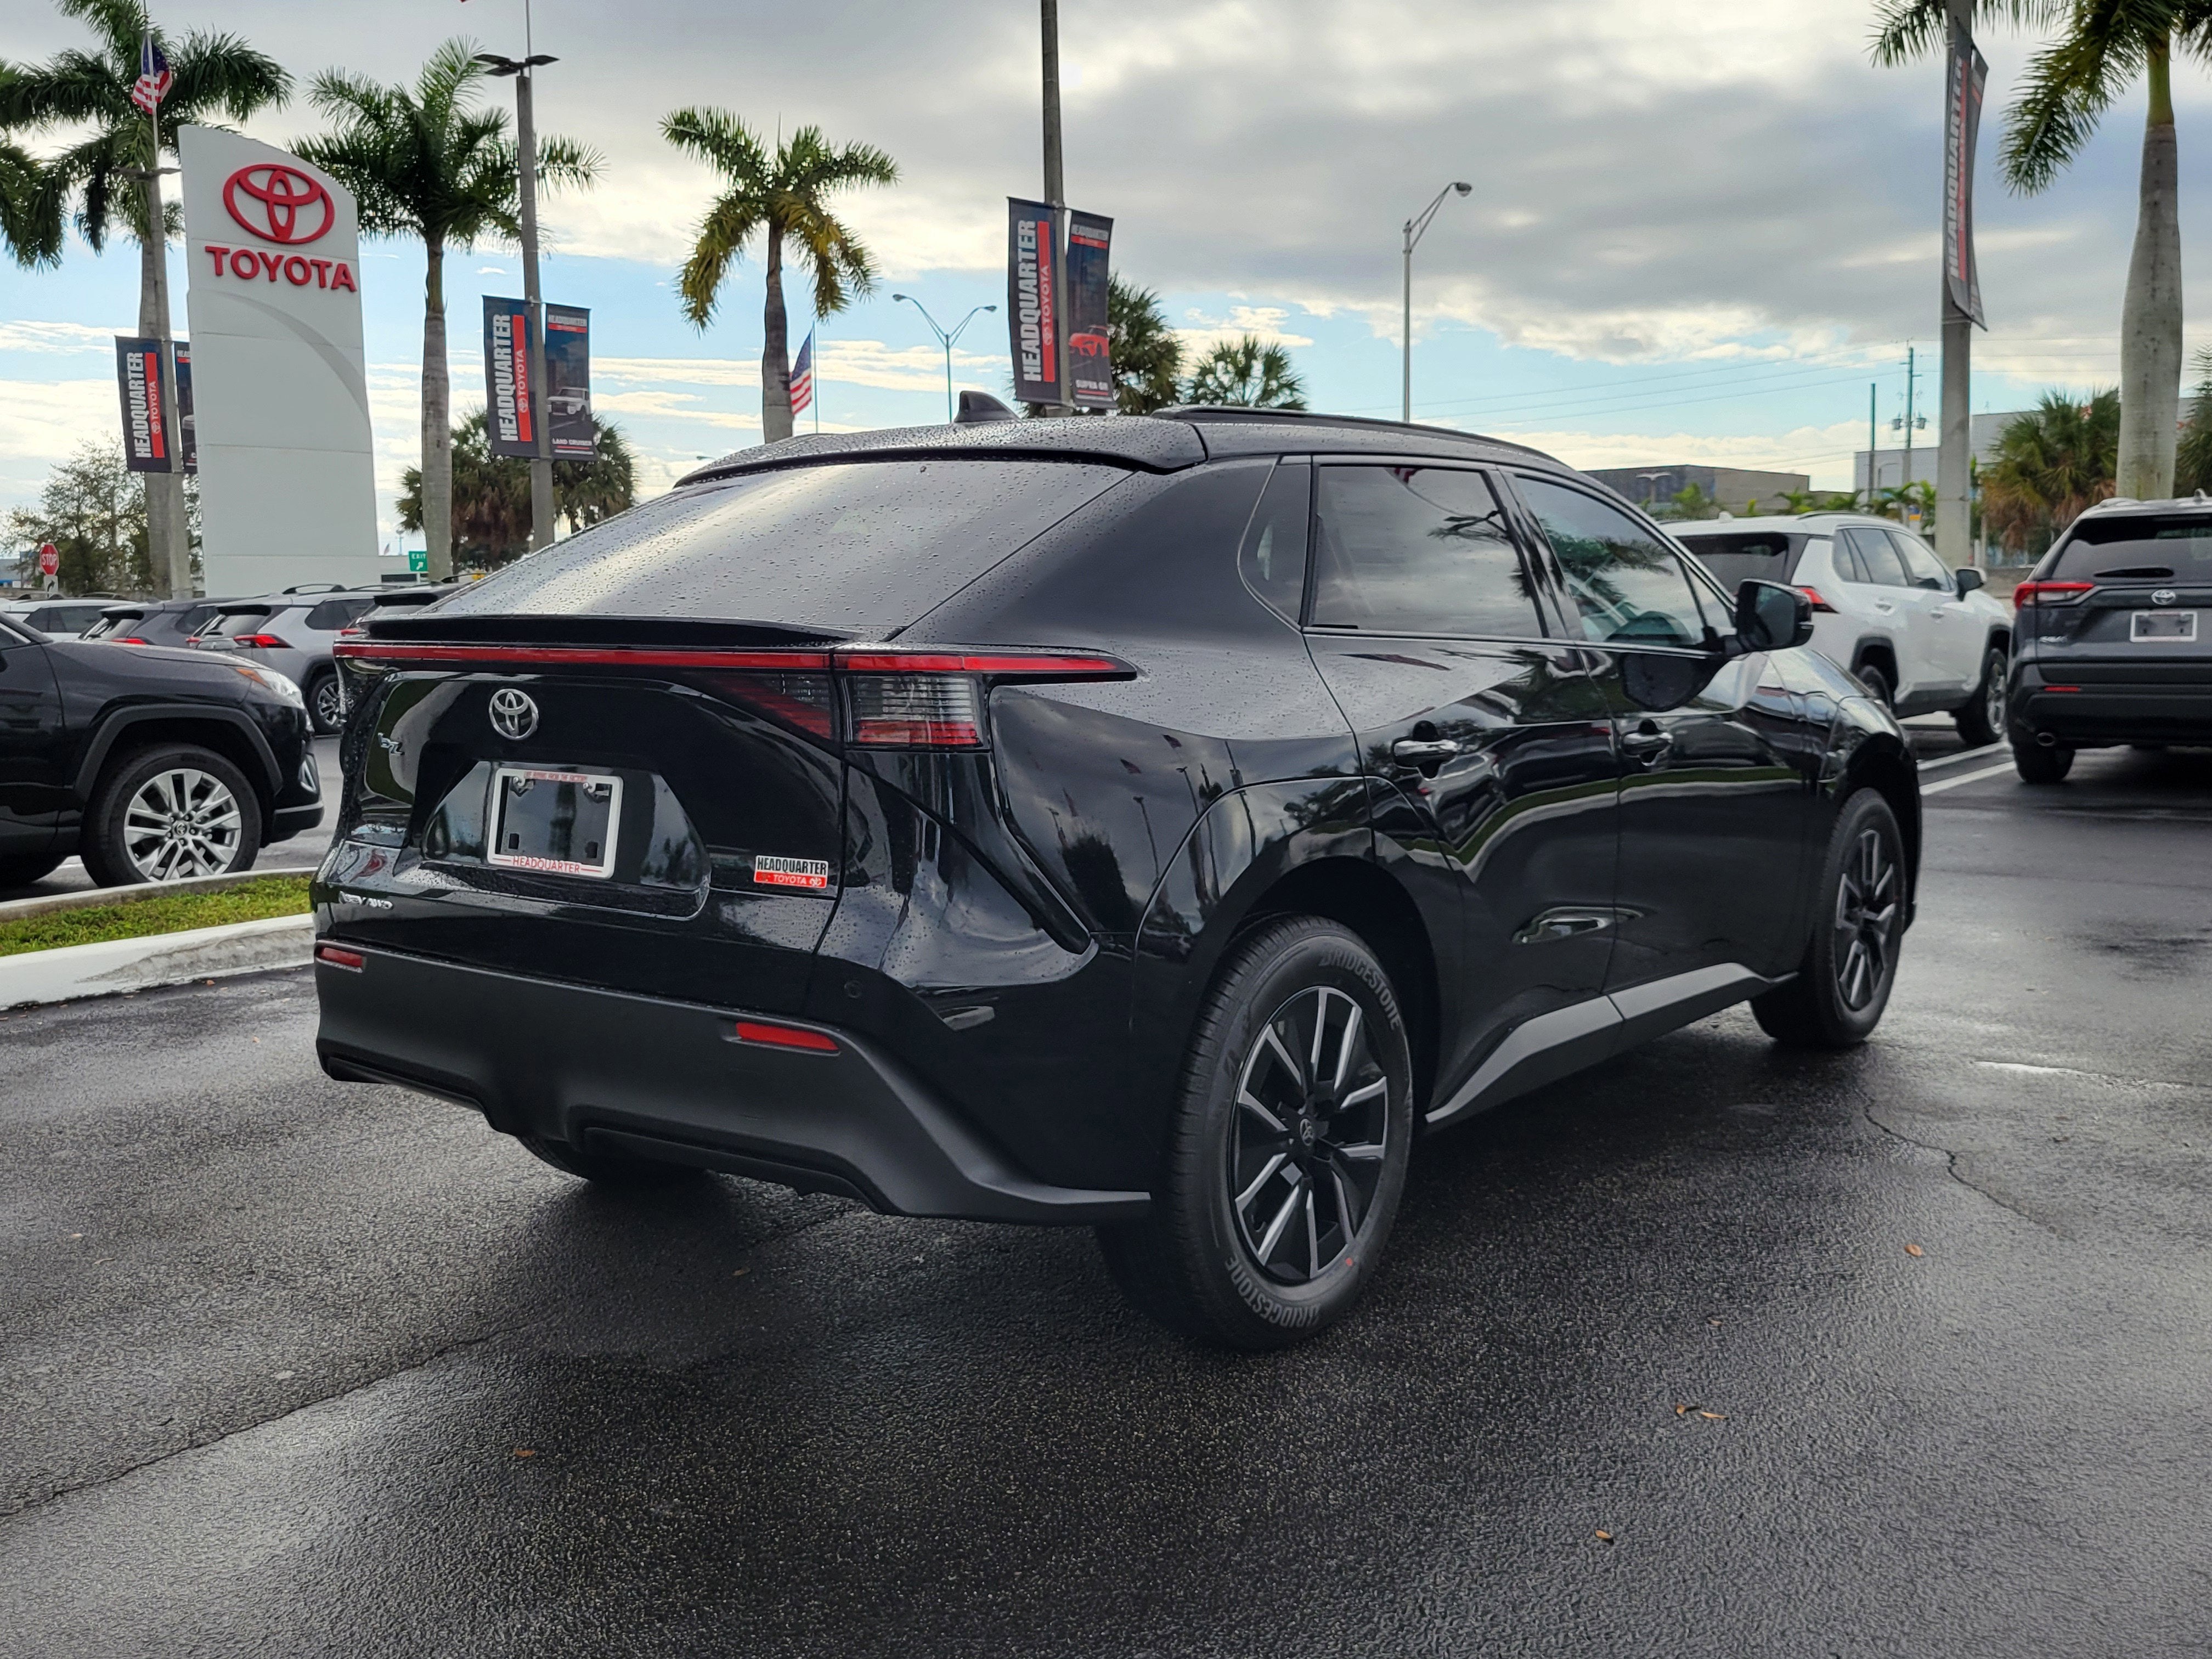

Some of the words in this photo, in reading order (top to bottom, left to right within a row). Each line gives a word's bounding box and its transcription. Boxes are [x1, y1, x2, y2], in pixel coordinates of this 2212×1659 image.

[205, 245, 357, 292] TOYOTA
[1017, 219, 1042, 382] HEADQUARTER
[1040, 266, 1052, 328] TOYOTA
[493, 313, 518, 442] HEADQUARTER
[516, 349, 526, 396] TOYOTA
[127, 352, 152, 458] HEADQUARTER
[149, 381, 158, 419] TOYOTA
[42, 554, 57, 566] STOP
[513, 856, 580, 873] HEADQUARTER
[757, 857, 826, 875] HEADQUARTER
[773, 874, 806, 884] TOYOTA
